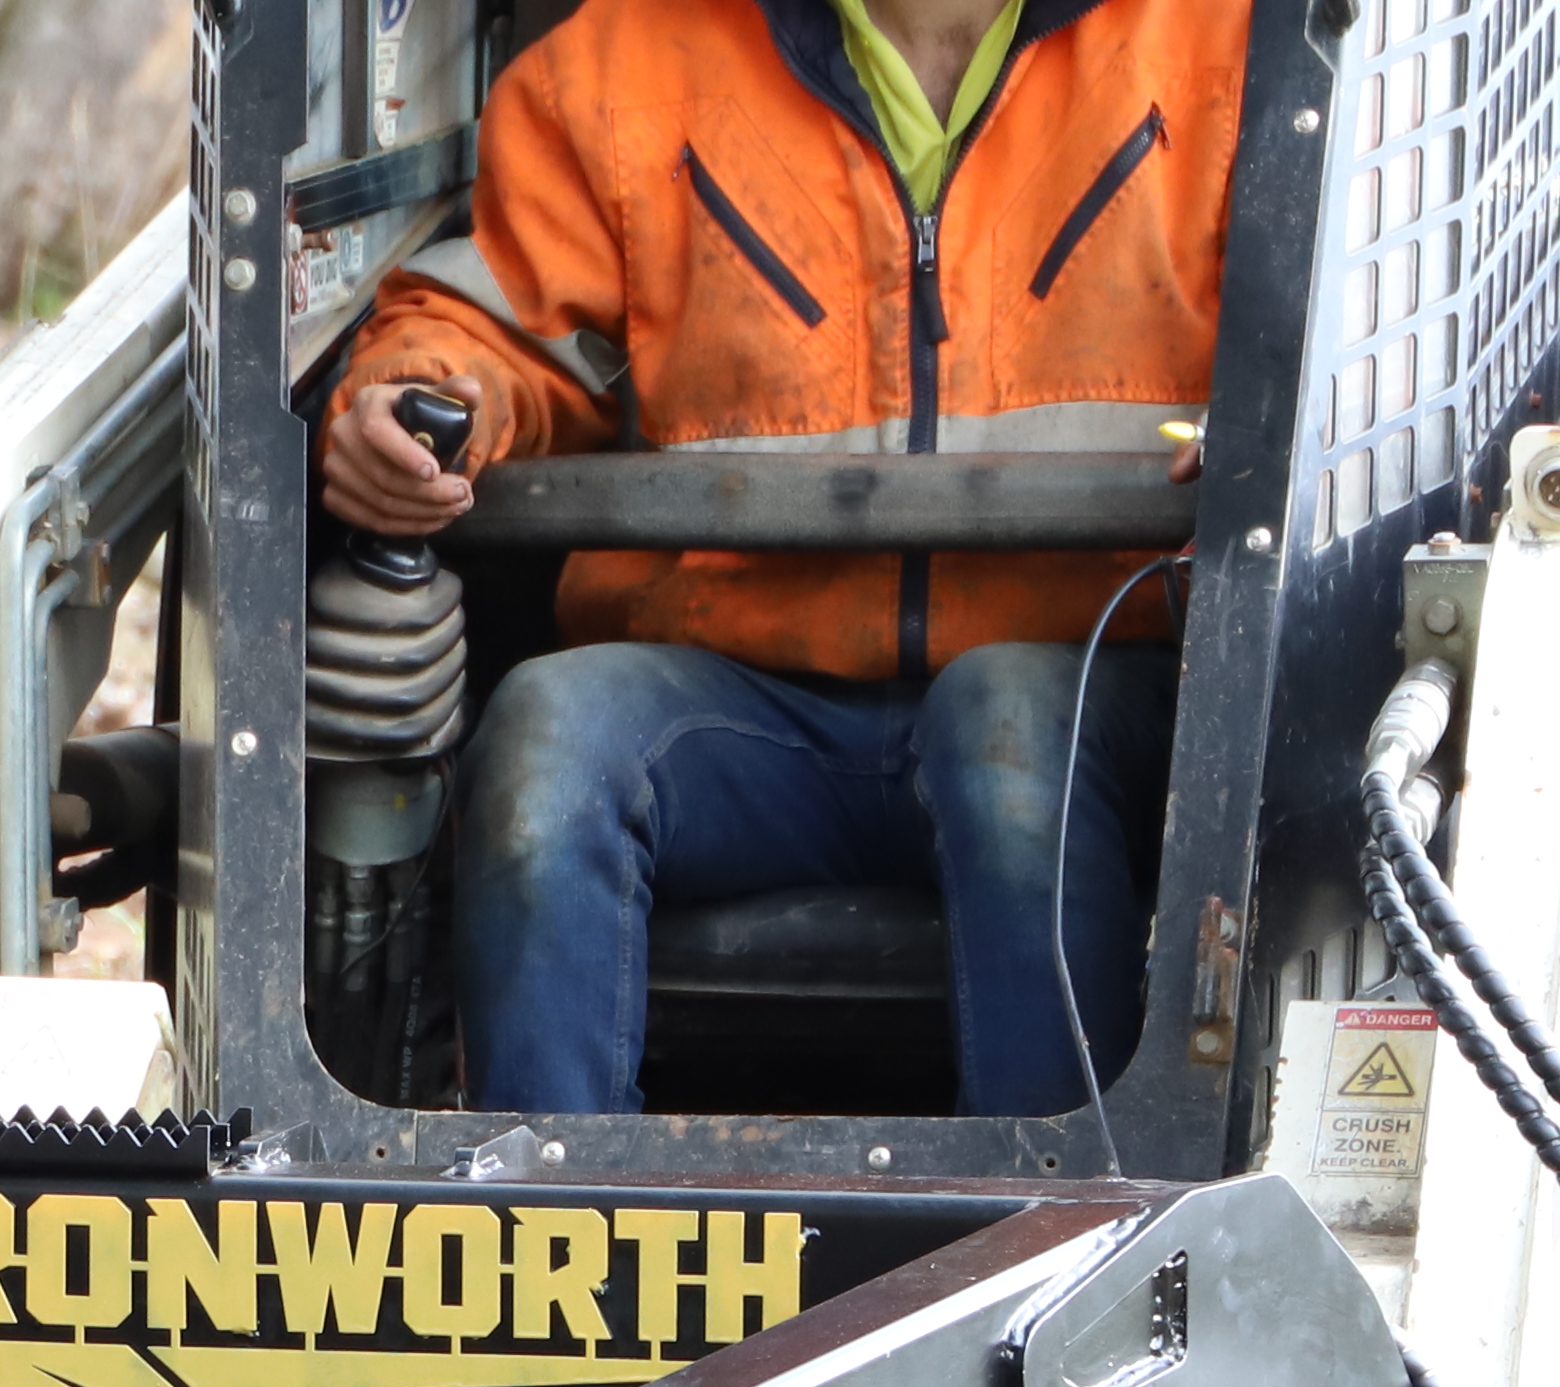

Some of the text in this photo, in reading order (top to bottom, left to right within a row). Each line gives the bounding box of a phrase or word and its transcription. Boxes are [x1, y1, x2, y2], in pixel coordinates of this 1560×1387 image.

[1365, 1014, 1432, 1026] DANGER
[1332, 1117, 1411, 1133] CRUSH
[1333, 1138, 1401, 1153] ZONE.
[1320, 1157, 1410, 1168] KEEP CLEAR.
